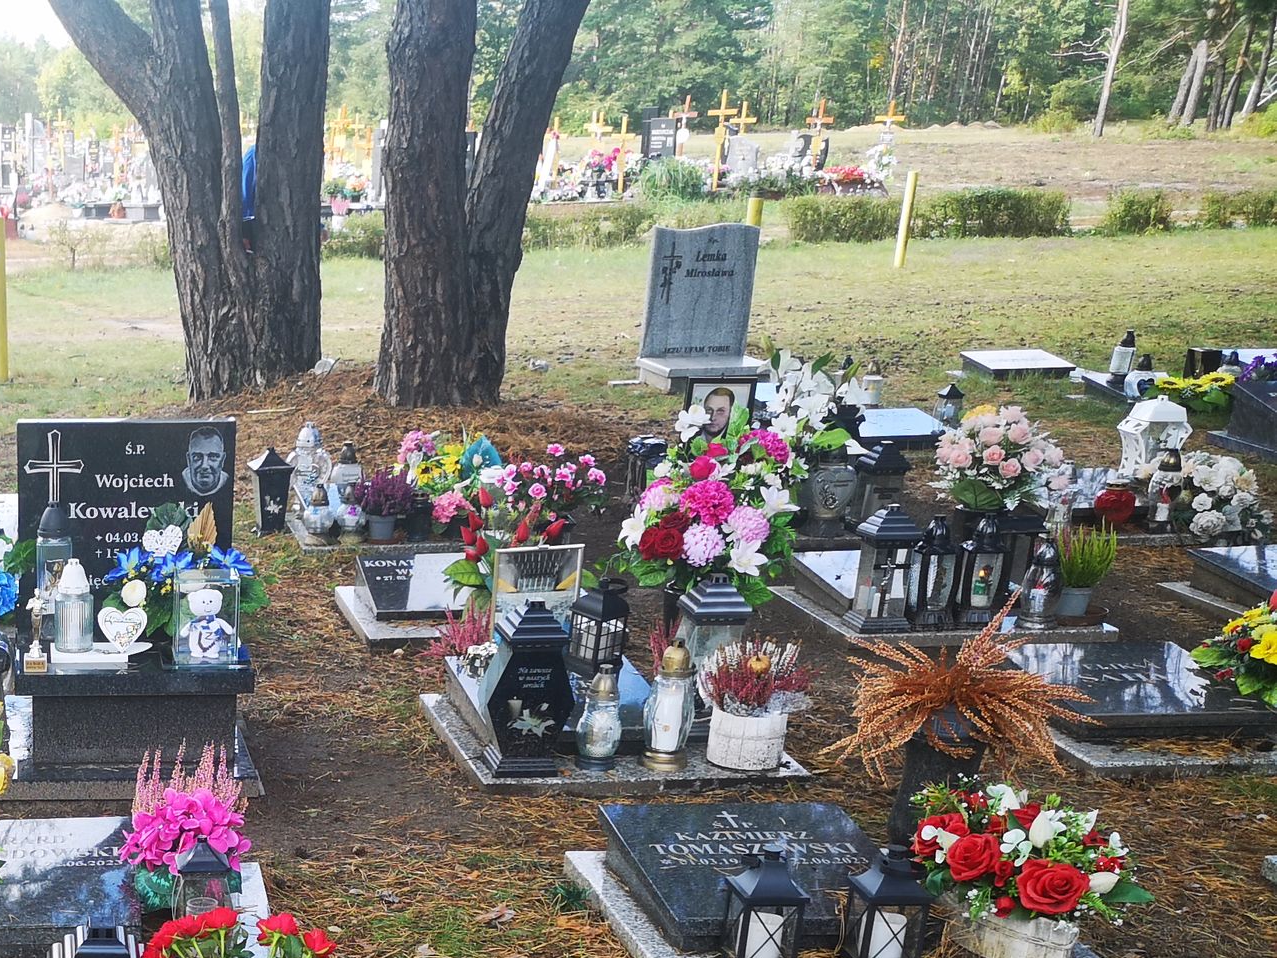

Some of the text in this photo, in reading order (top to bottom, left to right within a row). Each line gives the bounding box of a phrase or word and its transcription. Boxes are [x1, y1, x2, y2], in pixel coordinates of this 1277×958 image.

[95, 473, 174, 493] Wojciech
[68, 501, 199, 519] Kowaleki
[675, 830, 813, 841] KAZIMIERZ
[649, 842, 859, 856] TOMASZWSKI
